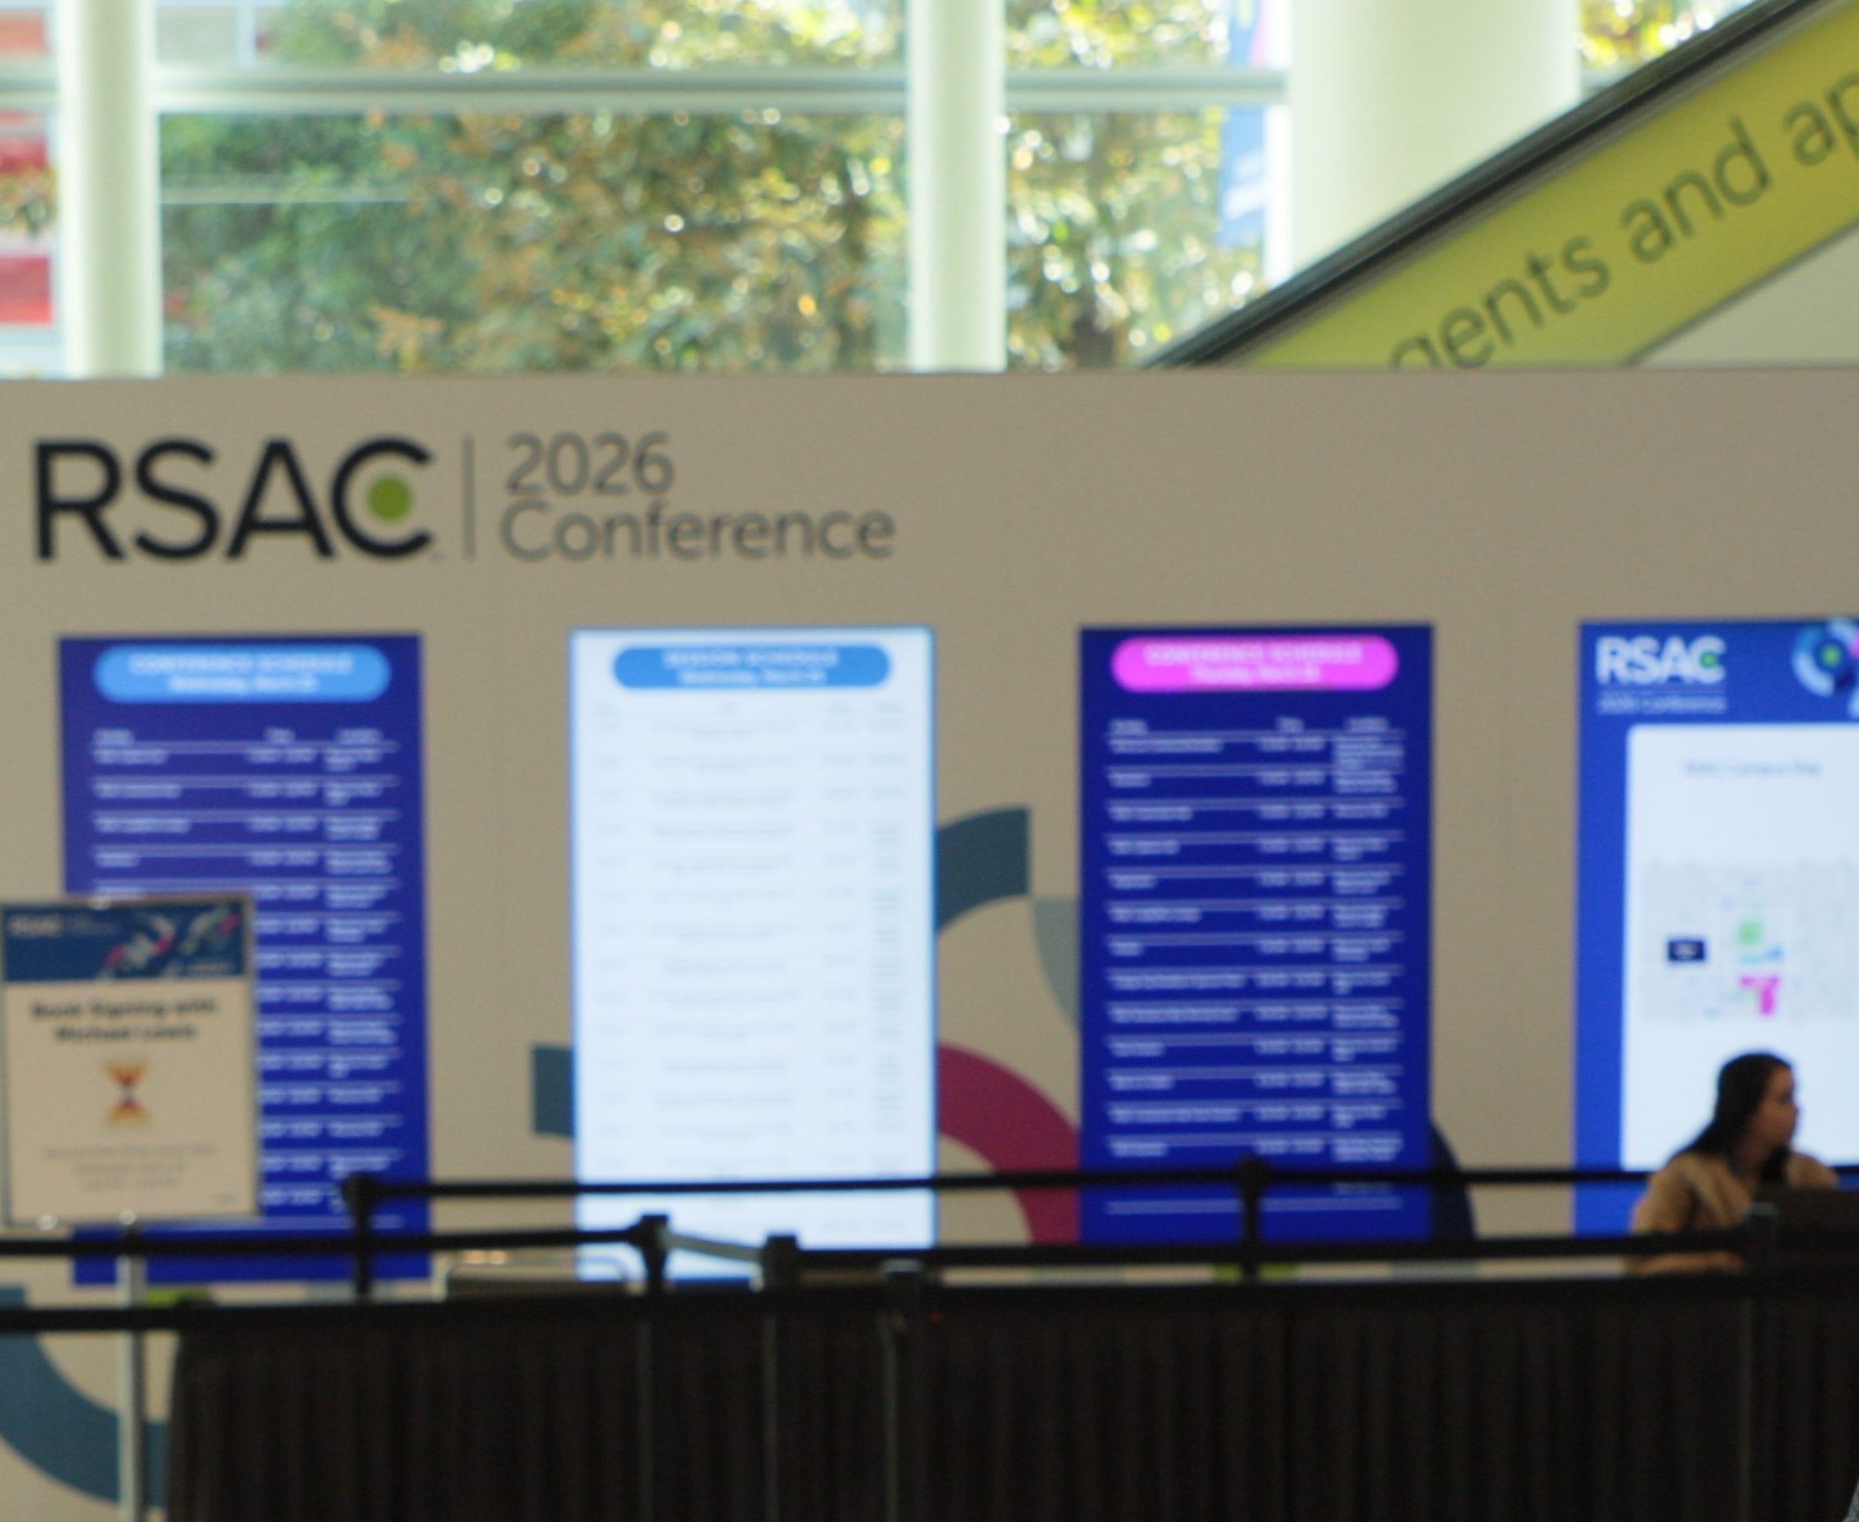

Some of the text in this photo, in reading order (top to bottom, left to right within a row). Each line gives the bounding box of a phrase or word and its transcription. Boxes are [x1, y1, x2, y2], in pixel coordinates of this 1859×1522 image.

[1619, 116, 1773, 263] and
[503, 431, 675, 496] 2026
[32, 436, 434, 561] RSAC
[501, 496, 895, 561] Conference
[1595, 636, 1726, 684] RSAC
